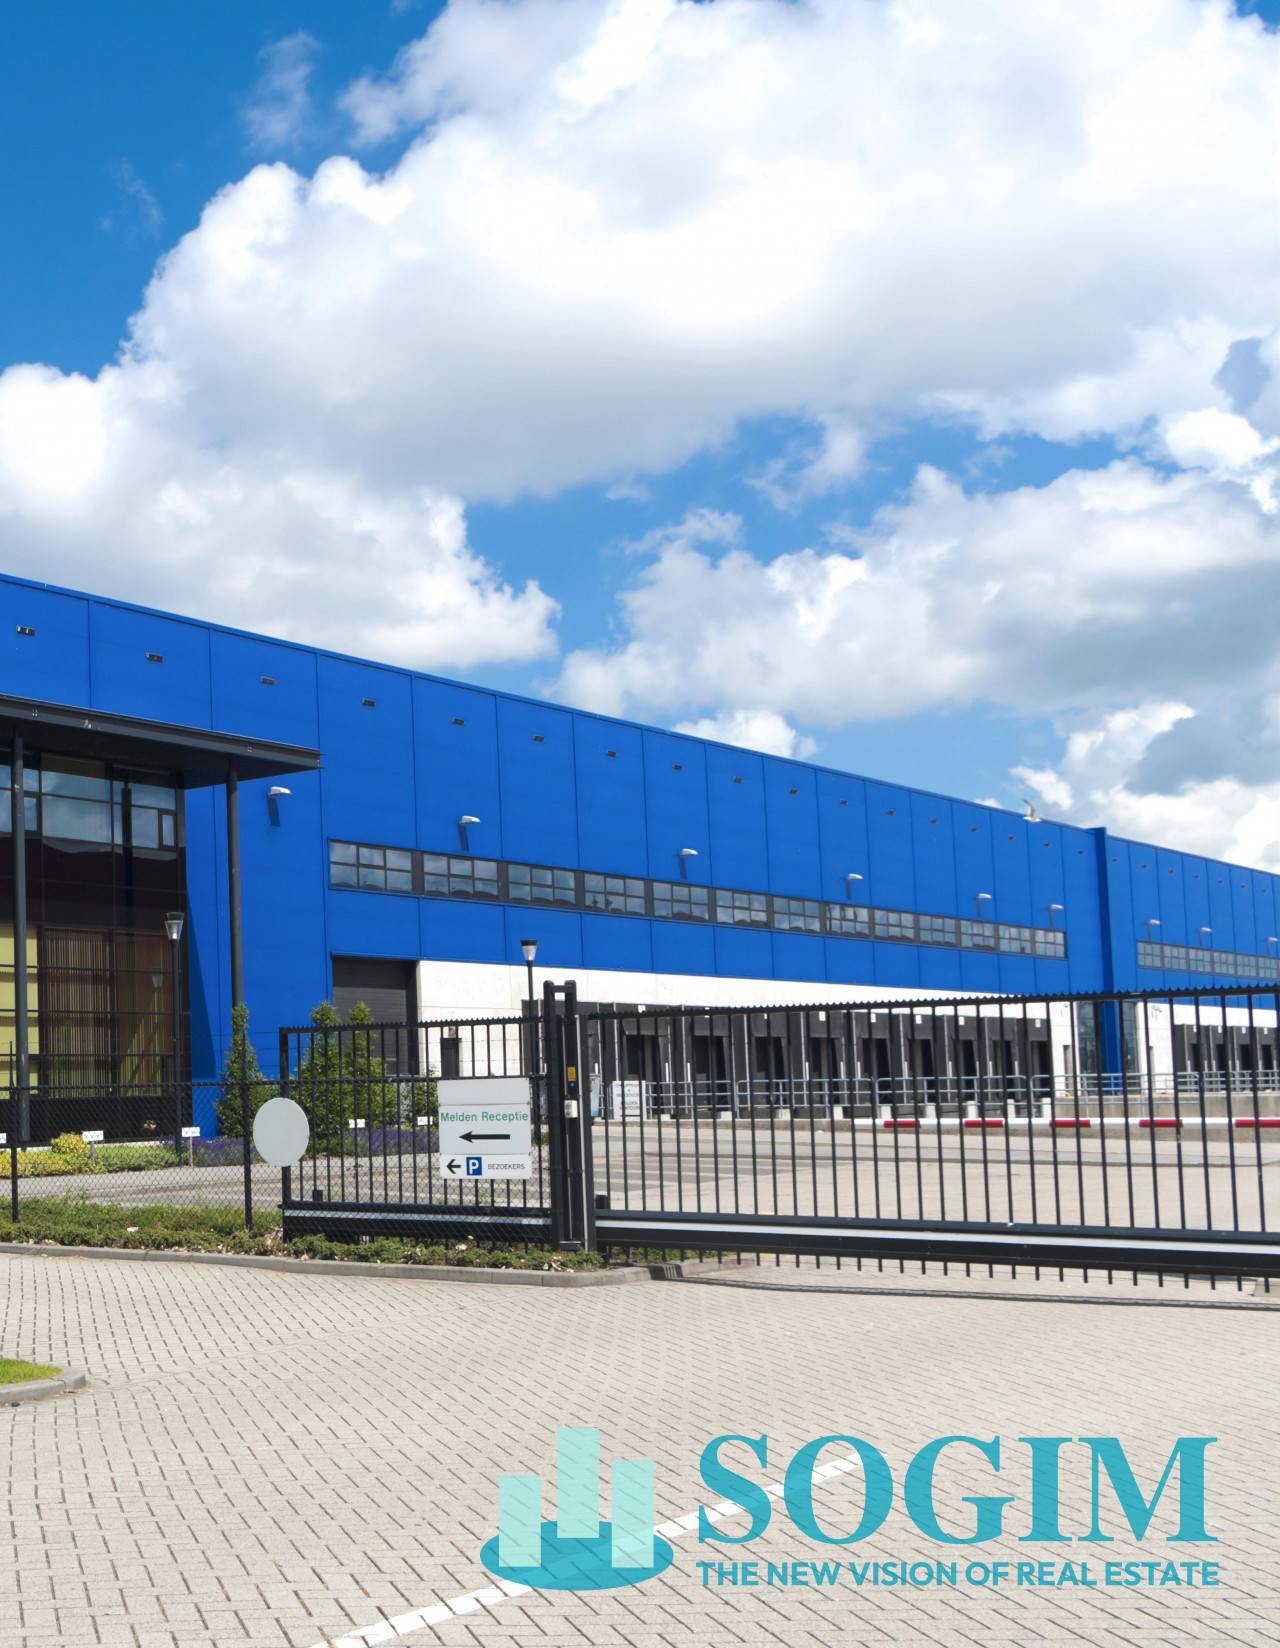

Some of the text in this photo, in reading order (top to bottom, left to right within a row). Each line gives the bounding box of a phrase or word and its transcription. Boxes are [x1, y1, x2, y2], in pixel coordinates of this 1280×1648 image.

[440, 1111, 529, 1122] Melden Receptie
[468, 1159, 480, 1175] P
